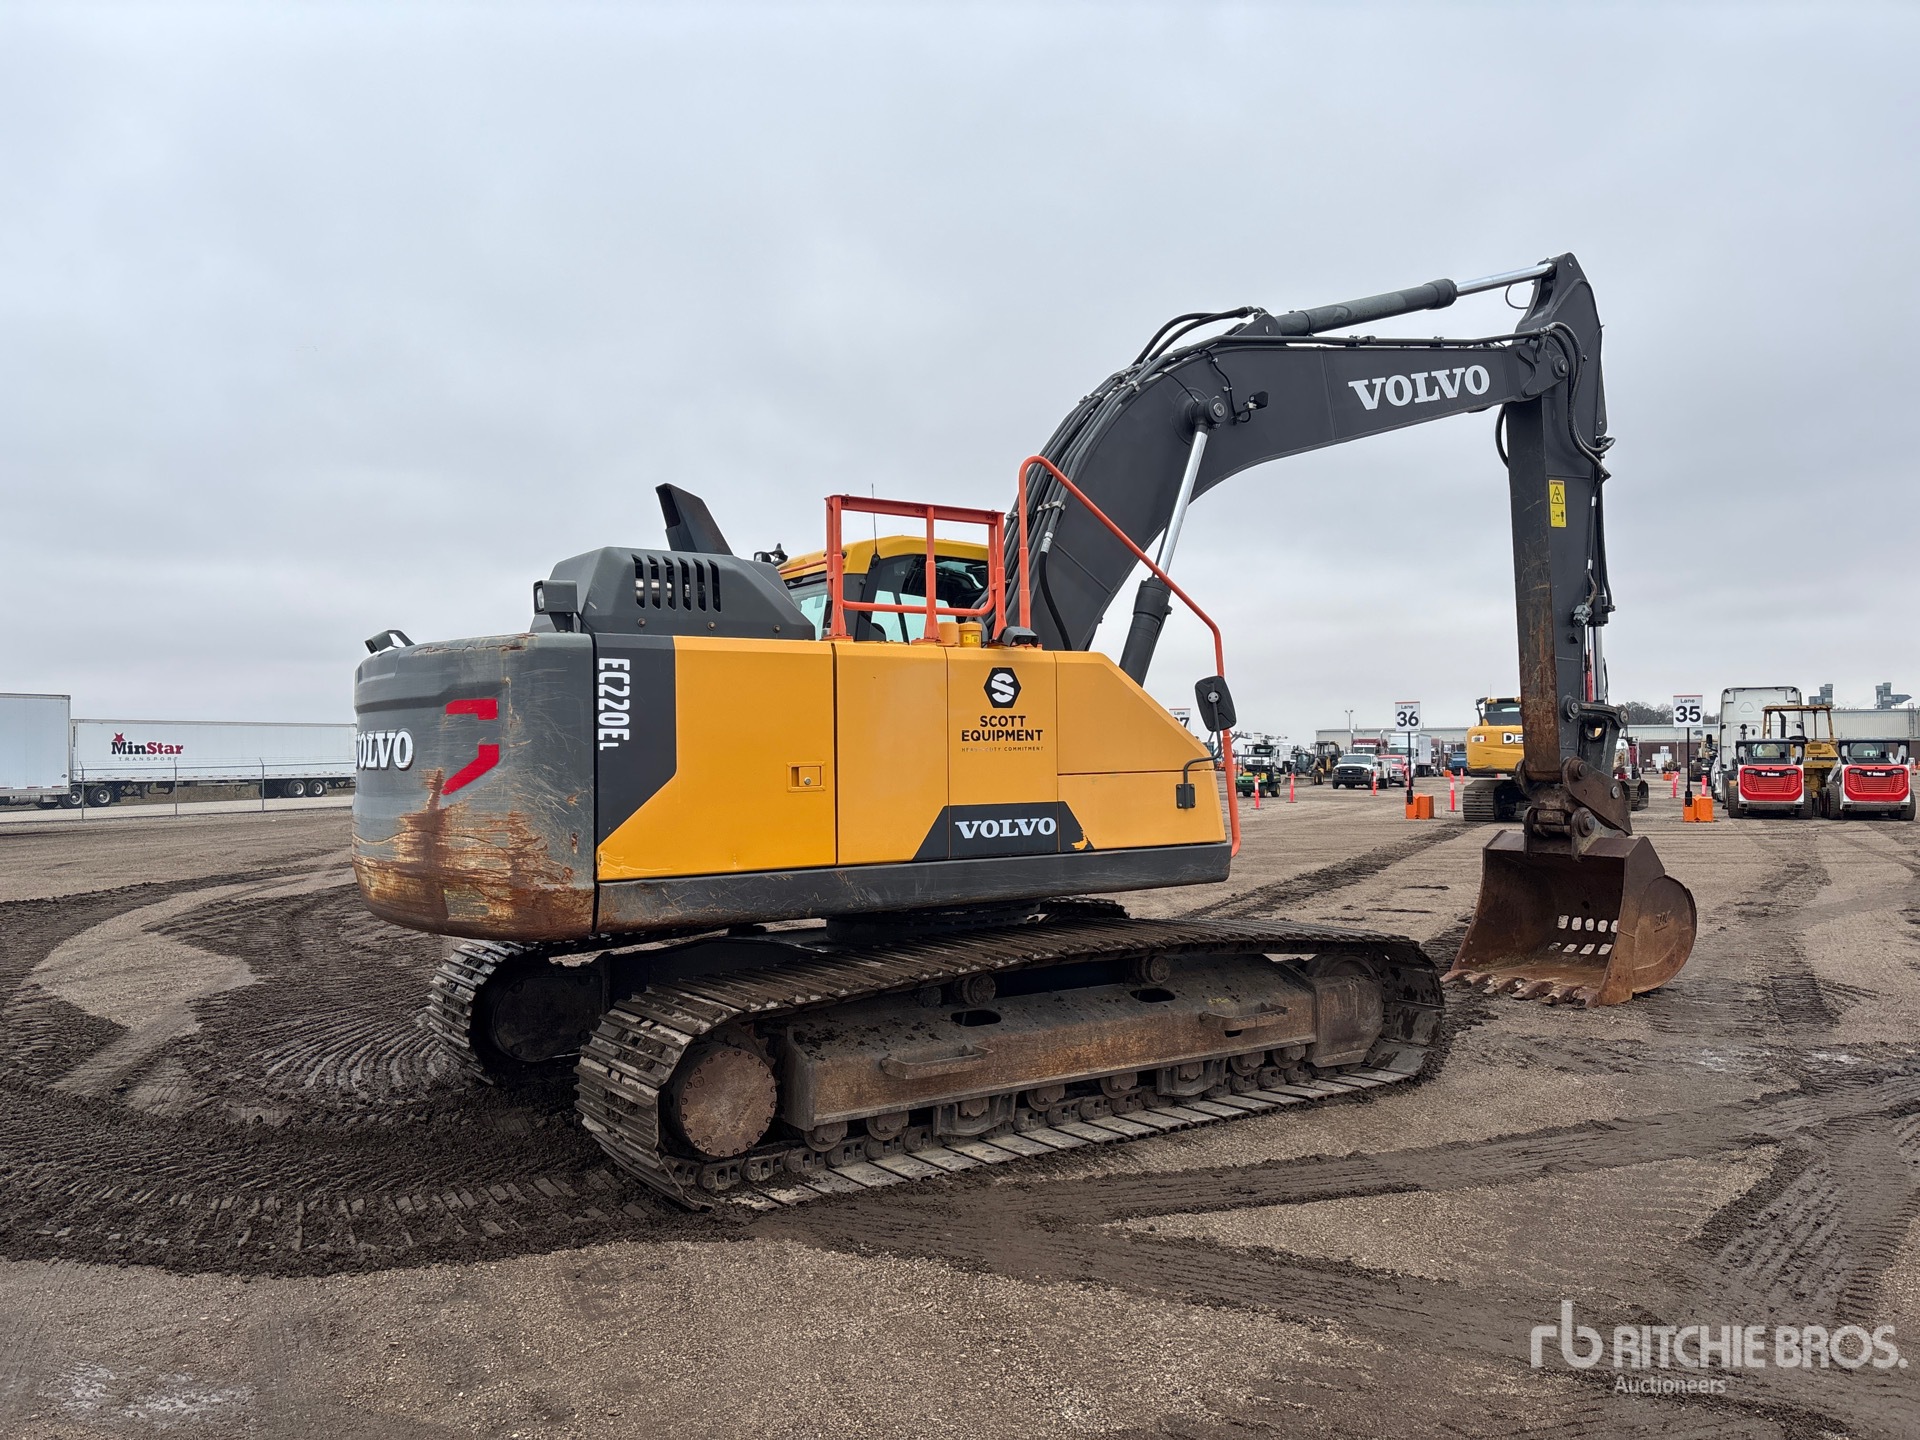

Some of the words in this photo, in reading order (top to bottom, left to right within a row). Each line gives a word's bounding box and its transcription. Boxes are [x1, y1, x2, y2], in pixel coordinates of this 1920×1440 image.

[1348, 365, 1490, 410] VOLVO
[979, 715, 1026, 728] SCOTT
[1396, 711, 1419, 727] 36
[1675, 705, 1702, 723] 35
[1174, 717, 1190, 728] 7
[961, 729, 1043, 742] EQUIPMENT
[111, 741, 184, 755] MinStar
[357, 730, 413, 769] OLVO
[955, 817, 1057, 839] VOLVO
